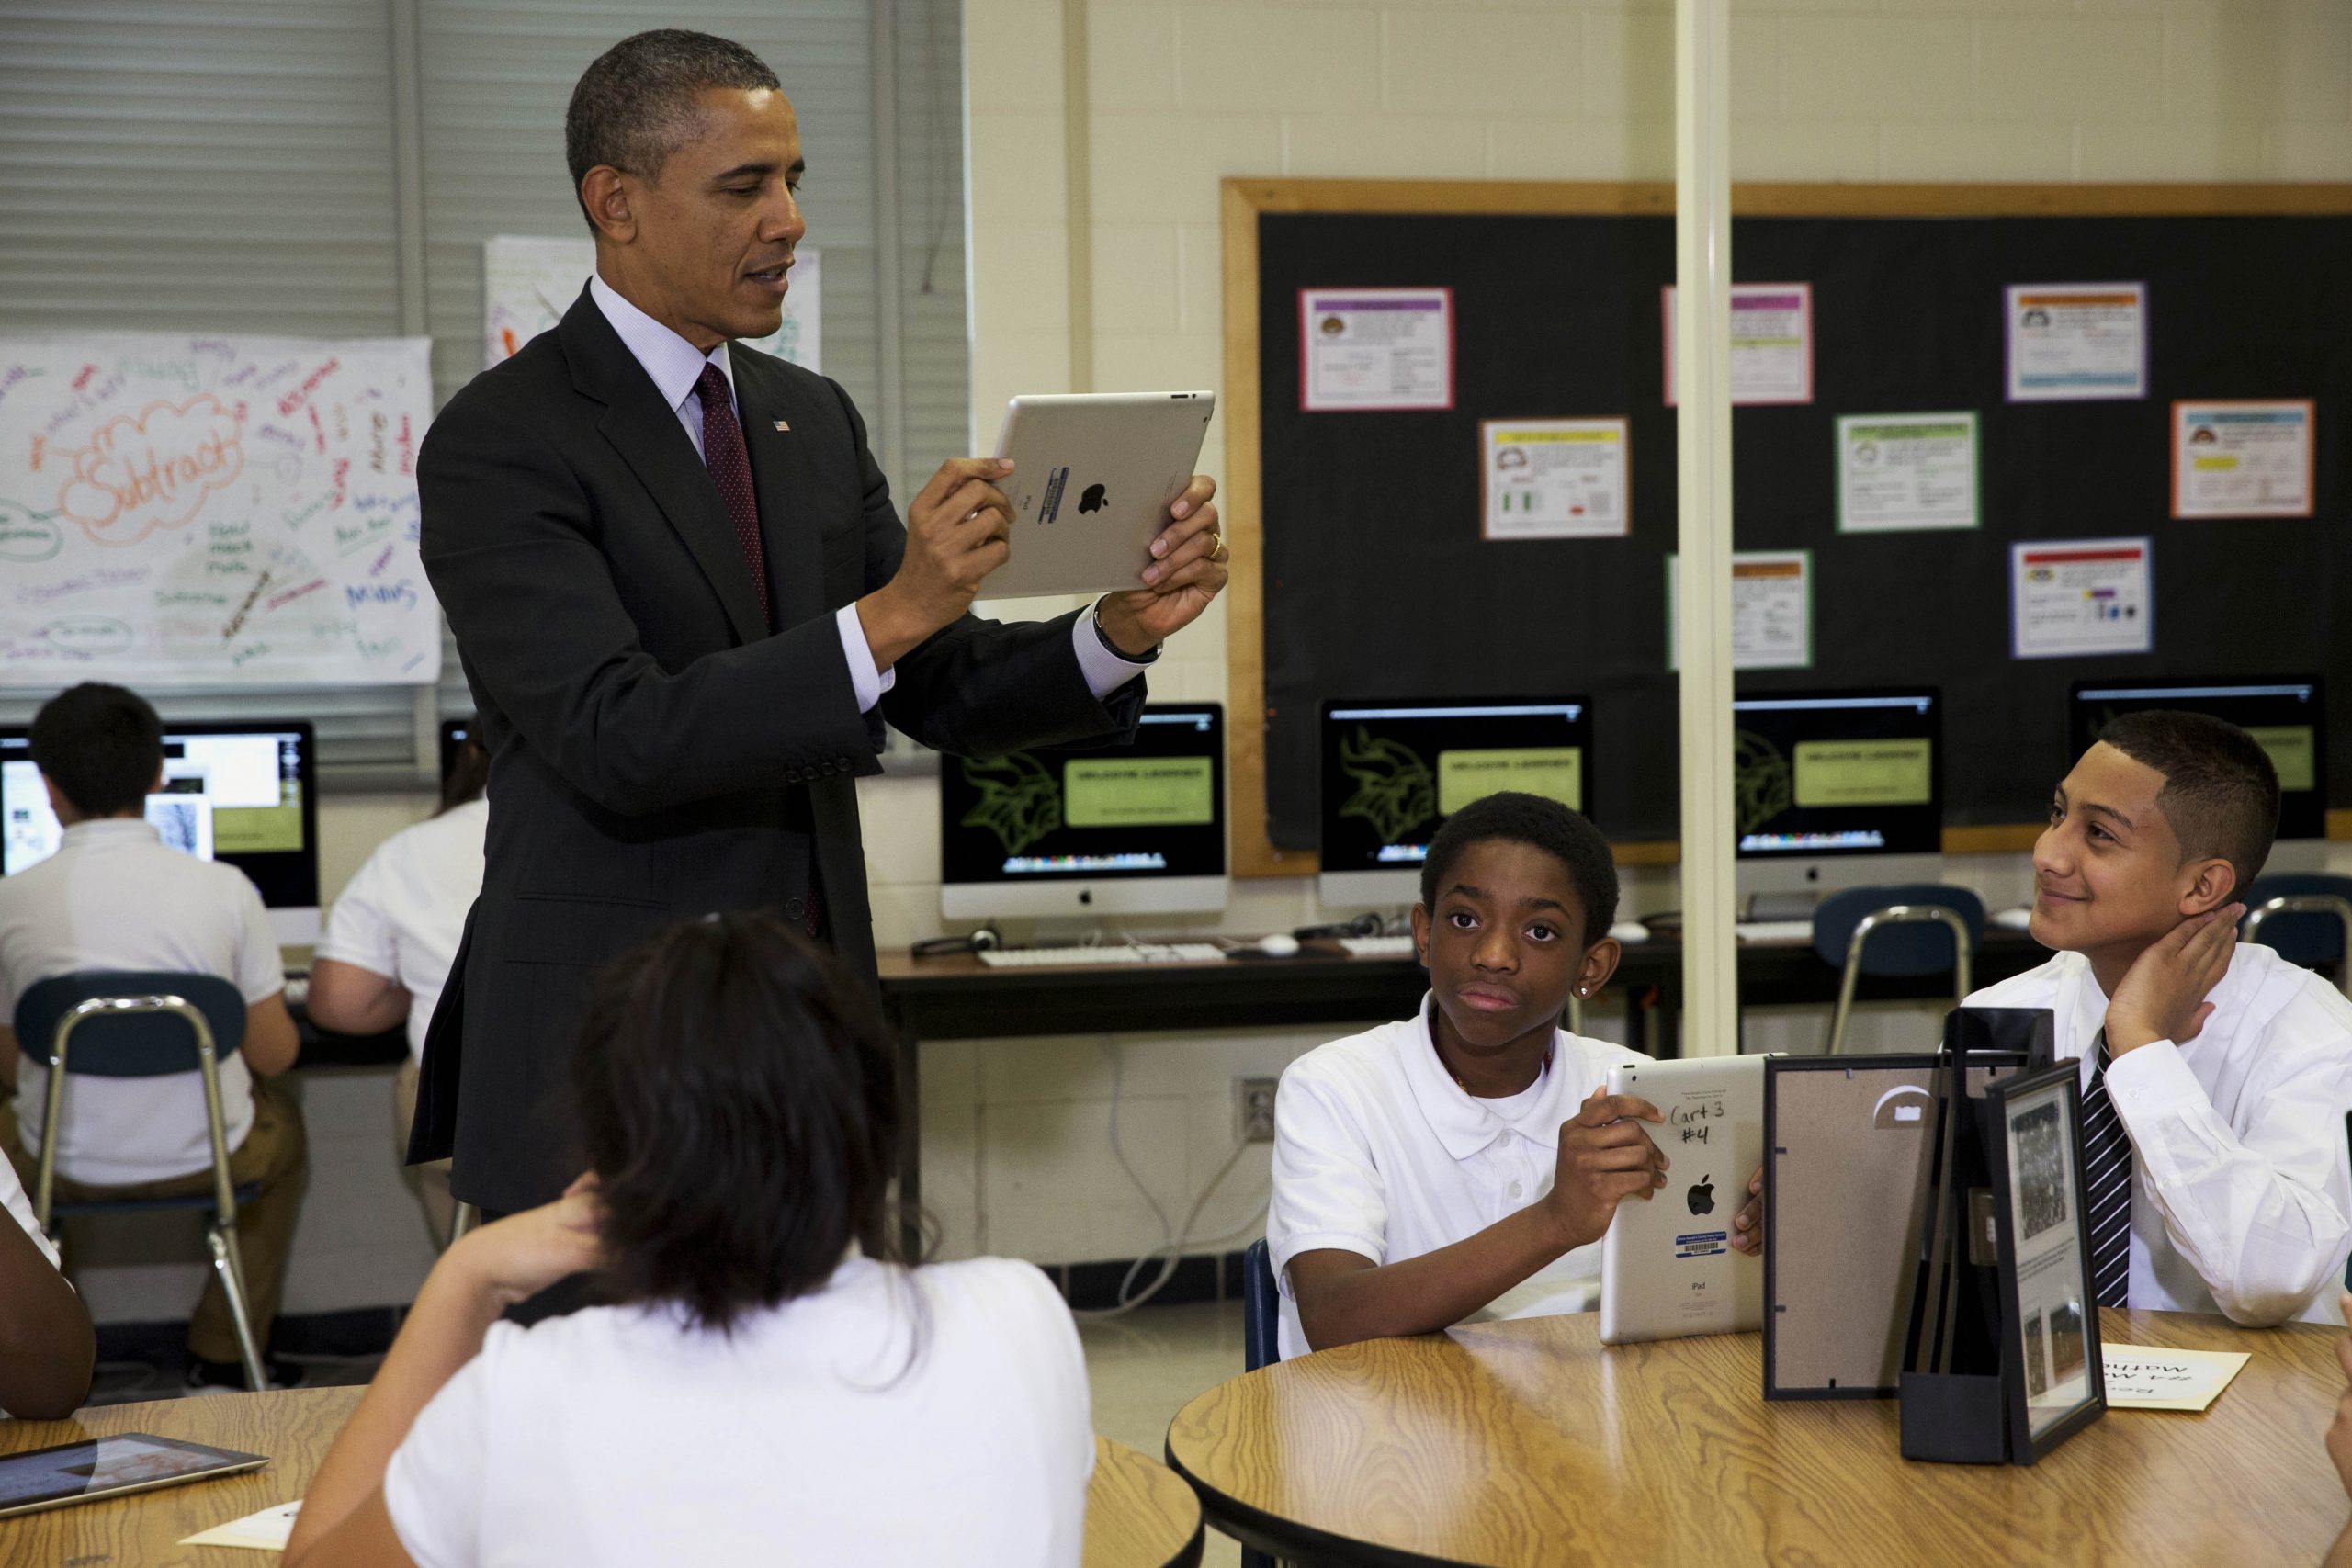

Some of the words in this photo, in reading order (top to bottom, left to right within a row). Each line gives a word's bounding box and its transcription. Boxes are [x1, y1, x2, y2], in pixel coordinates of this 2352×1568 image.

[1670, 1102, 1709, 1126] Cart
[1713, 1100, 1724, 1118] 3
[1681, 1125, 1709, 1145] #4
[1691, 1281, 1706, 1291] iPad
